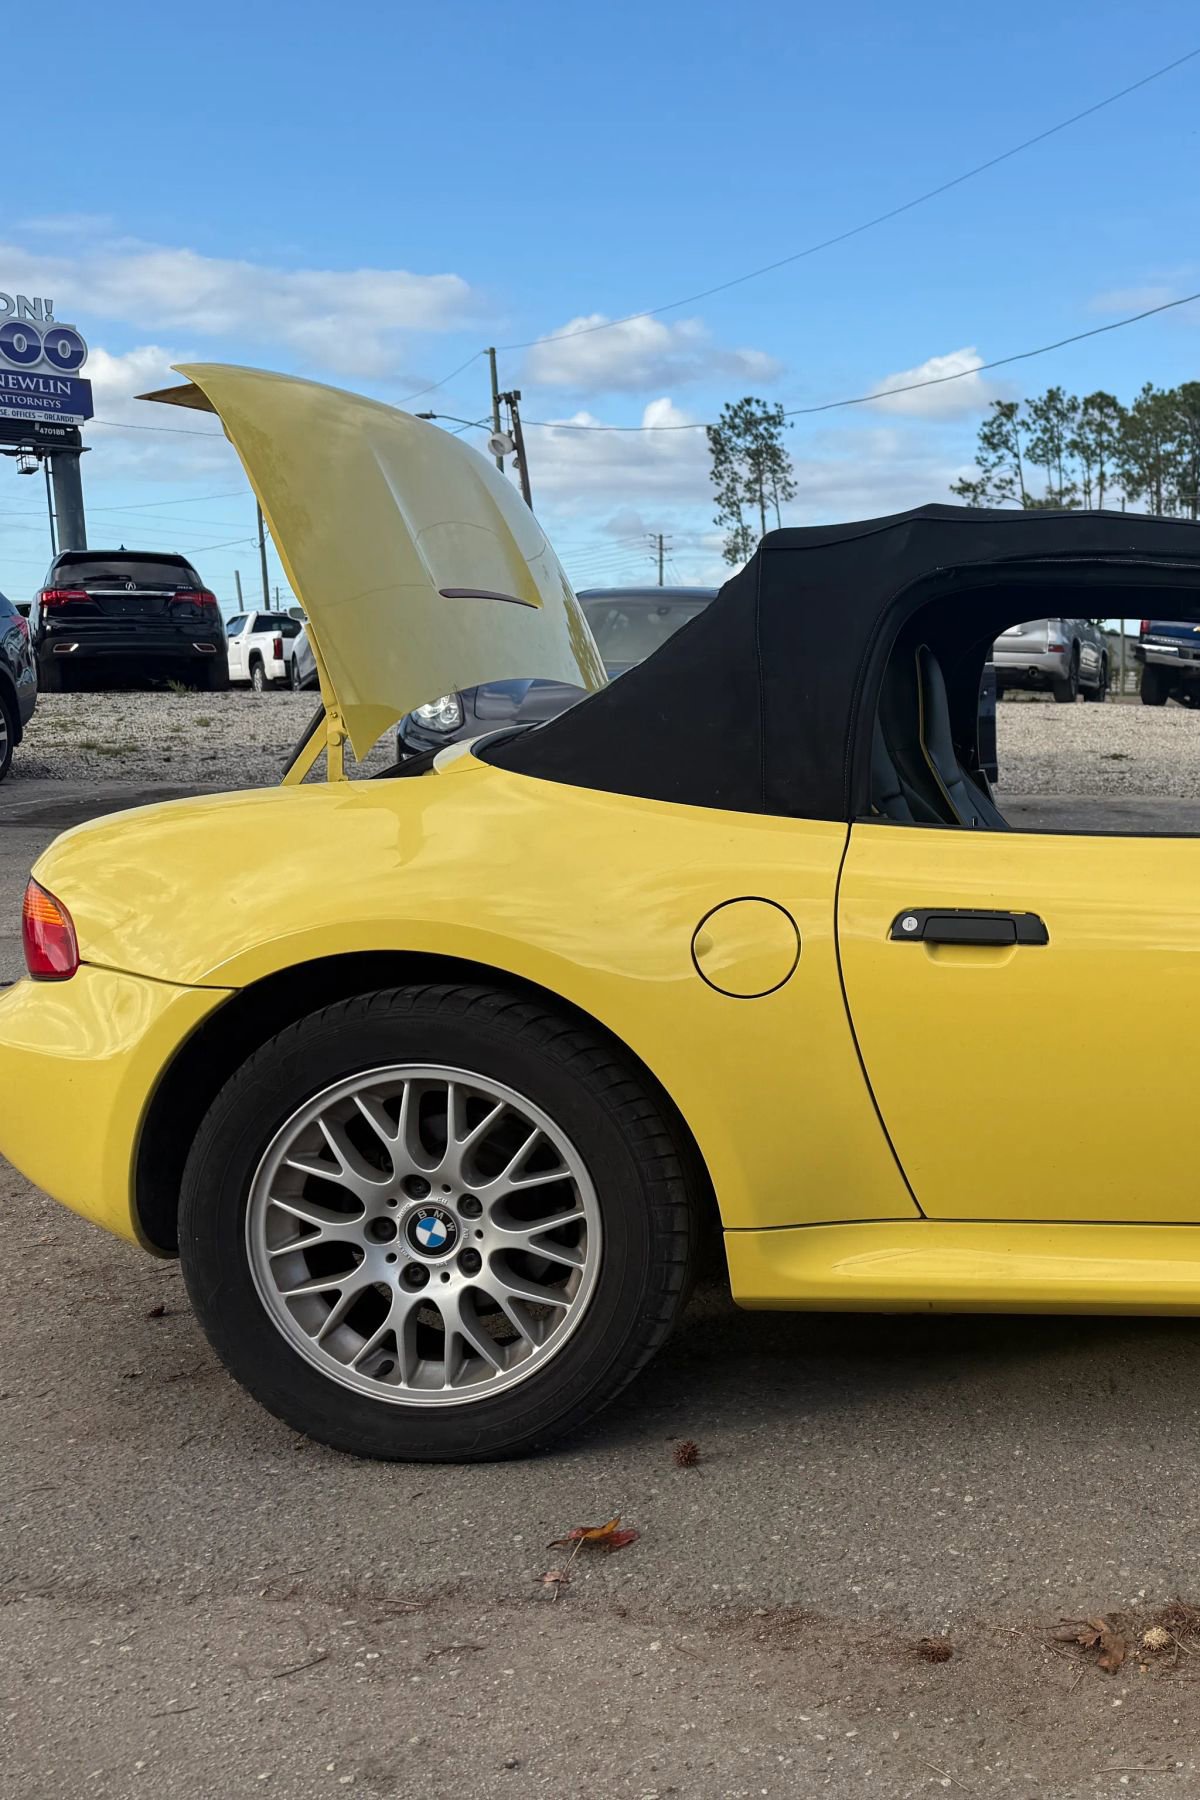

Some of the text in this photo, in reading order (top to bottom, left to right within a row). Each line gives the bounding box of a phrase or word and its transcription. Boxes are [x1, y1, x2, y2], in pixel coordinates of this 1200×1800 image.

[12, 409, 36, 419] OFFICES
[44, 413, 74, 423] ORLANDO
[418, 1209, 456, 1232] BMW
